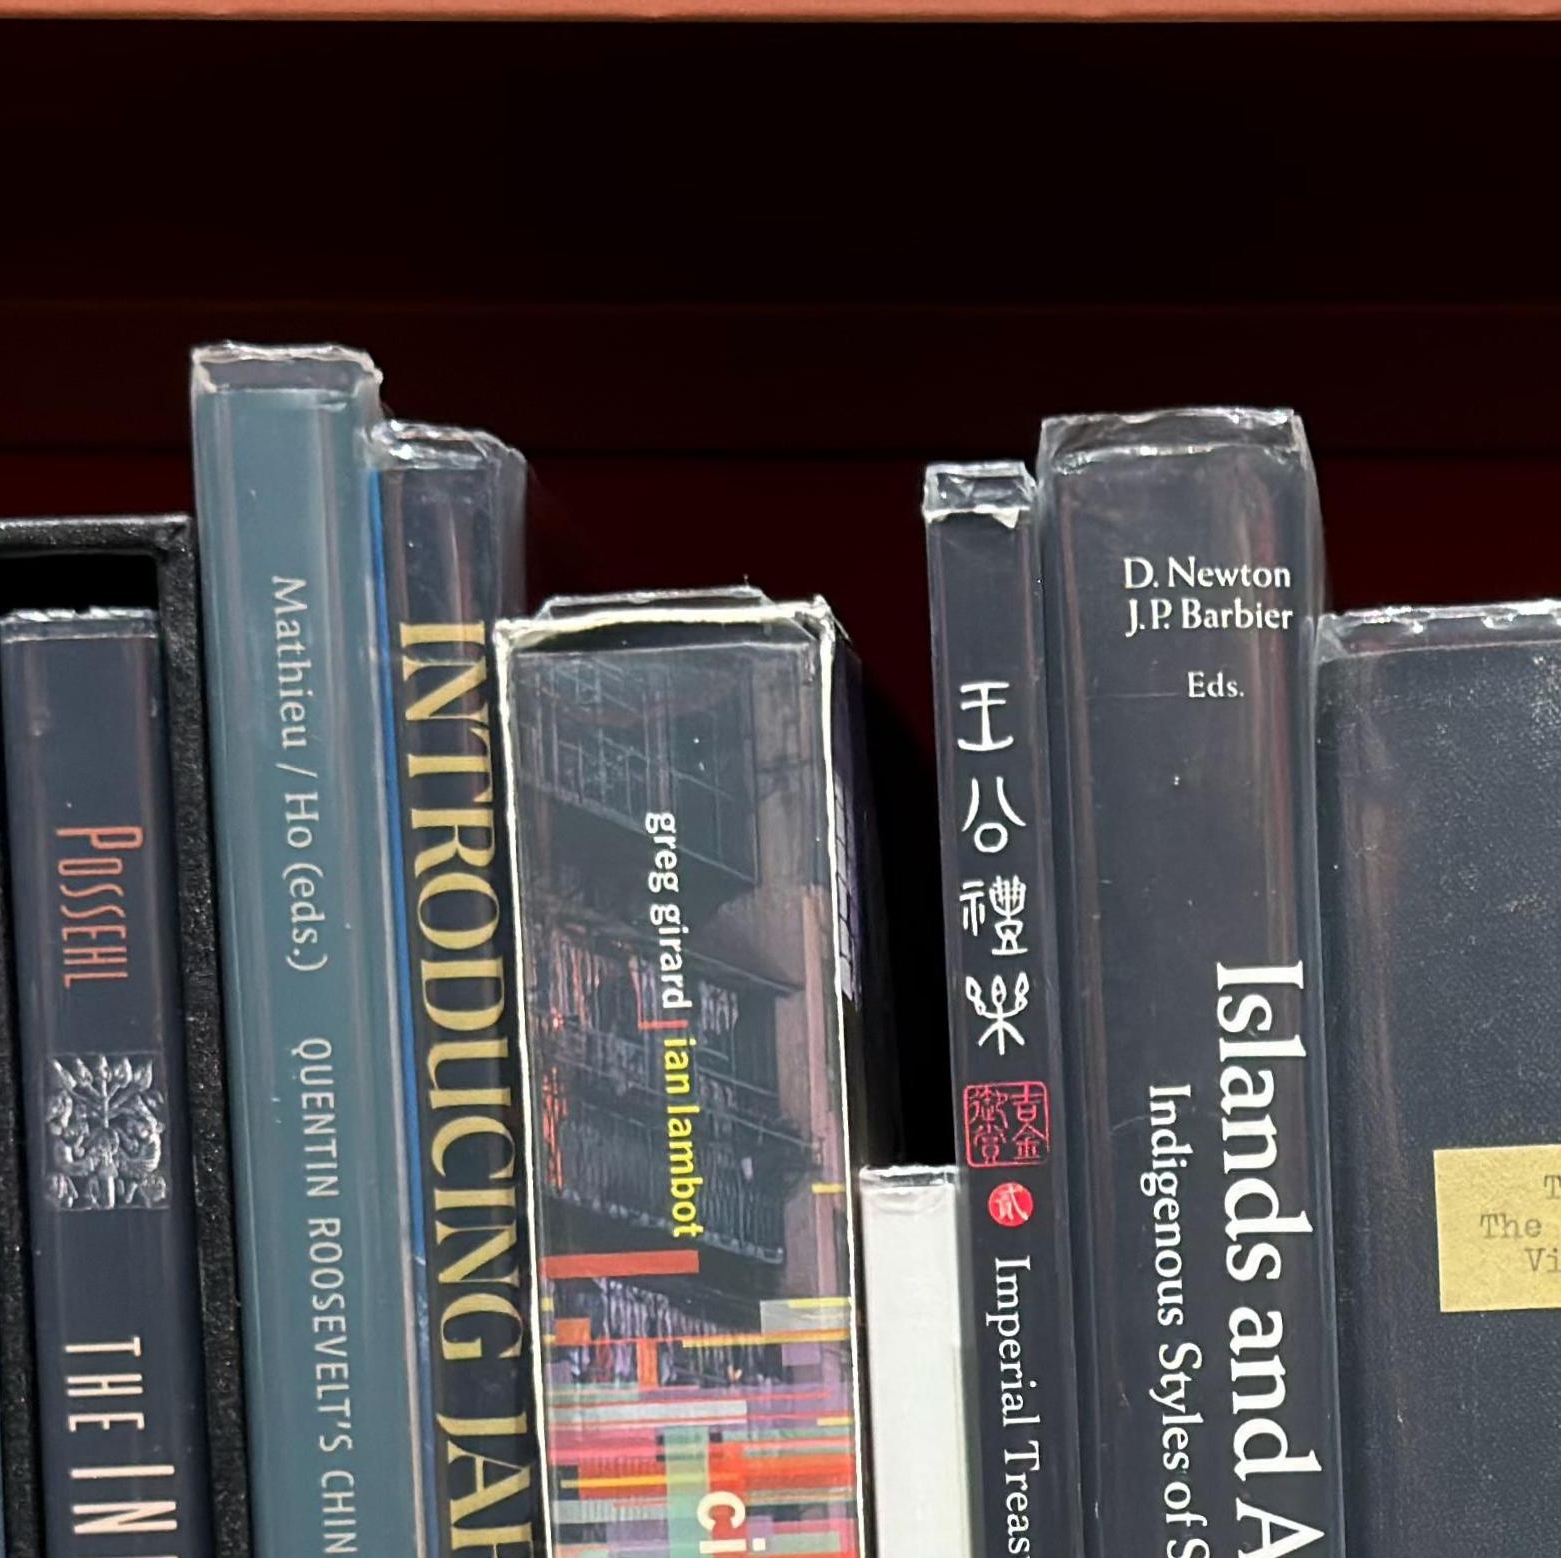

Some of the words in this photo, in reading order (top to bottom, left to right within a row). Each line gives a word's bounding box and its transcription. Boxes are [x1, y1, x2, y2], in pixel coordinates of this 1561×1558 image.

[1123, 557, 1159, 588] D.
[1168, 556, 1291, 588] Newton
[1188, 671, 1244, 698] Eds.
[644, 811, 681, 894] greg
[399, 620, 524, 1361] INTRODUCING
[649, 903, 692, 1010] girard
[291, 1038, 340, 1197] QUENTIN
[662, 1037, 698, 1096] ian
[1215, 959, 1314, 1282] Islands
[666, 1104, 705, 1239] lambot
[1141, 1083, 1194, 1327] Indigenous
[1480, 1213, 1543, 1240] The
[63, 1335, 146, 1433] THE
[308, 1217, 354, 1452] ROOSEVELT'S
[986, 1256, 1041, 1428] Imperial
[1229, 1306, 1323, 1482] and
[1149, 1341, 1205, 1472] Styles
[1164, 1481, 1208, 1528] of
